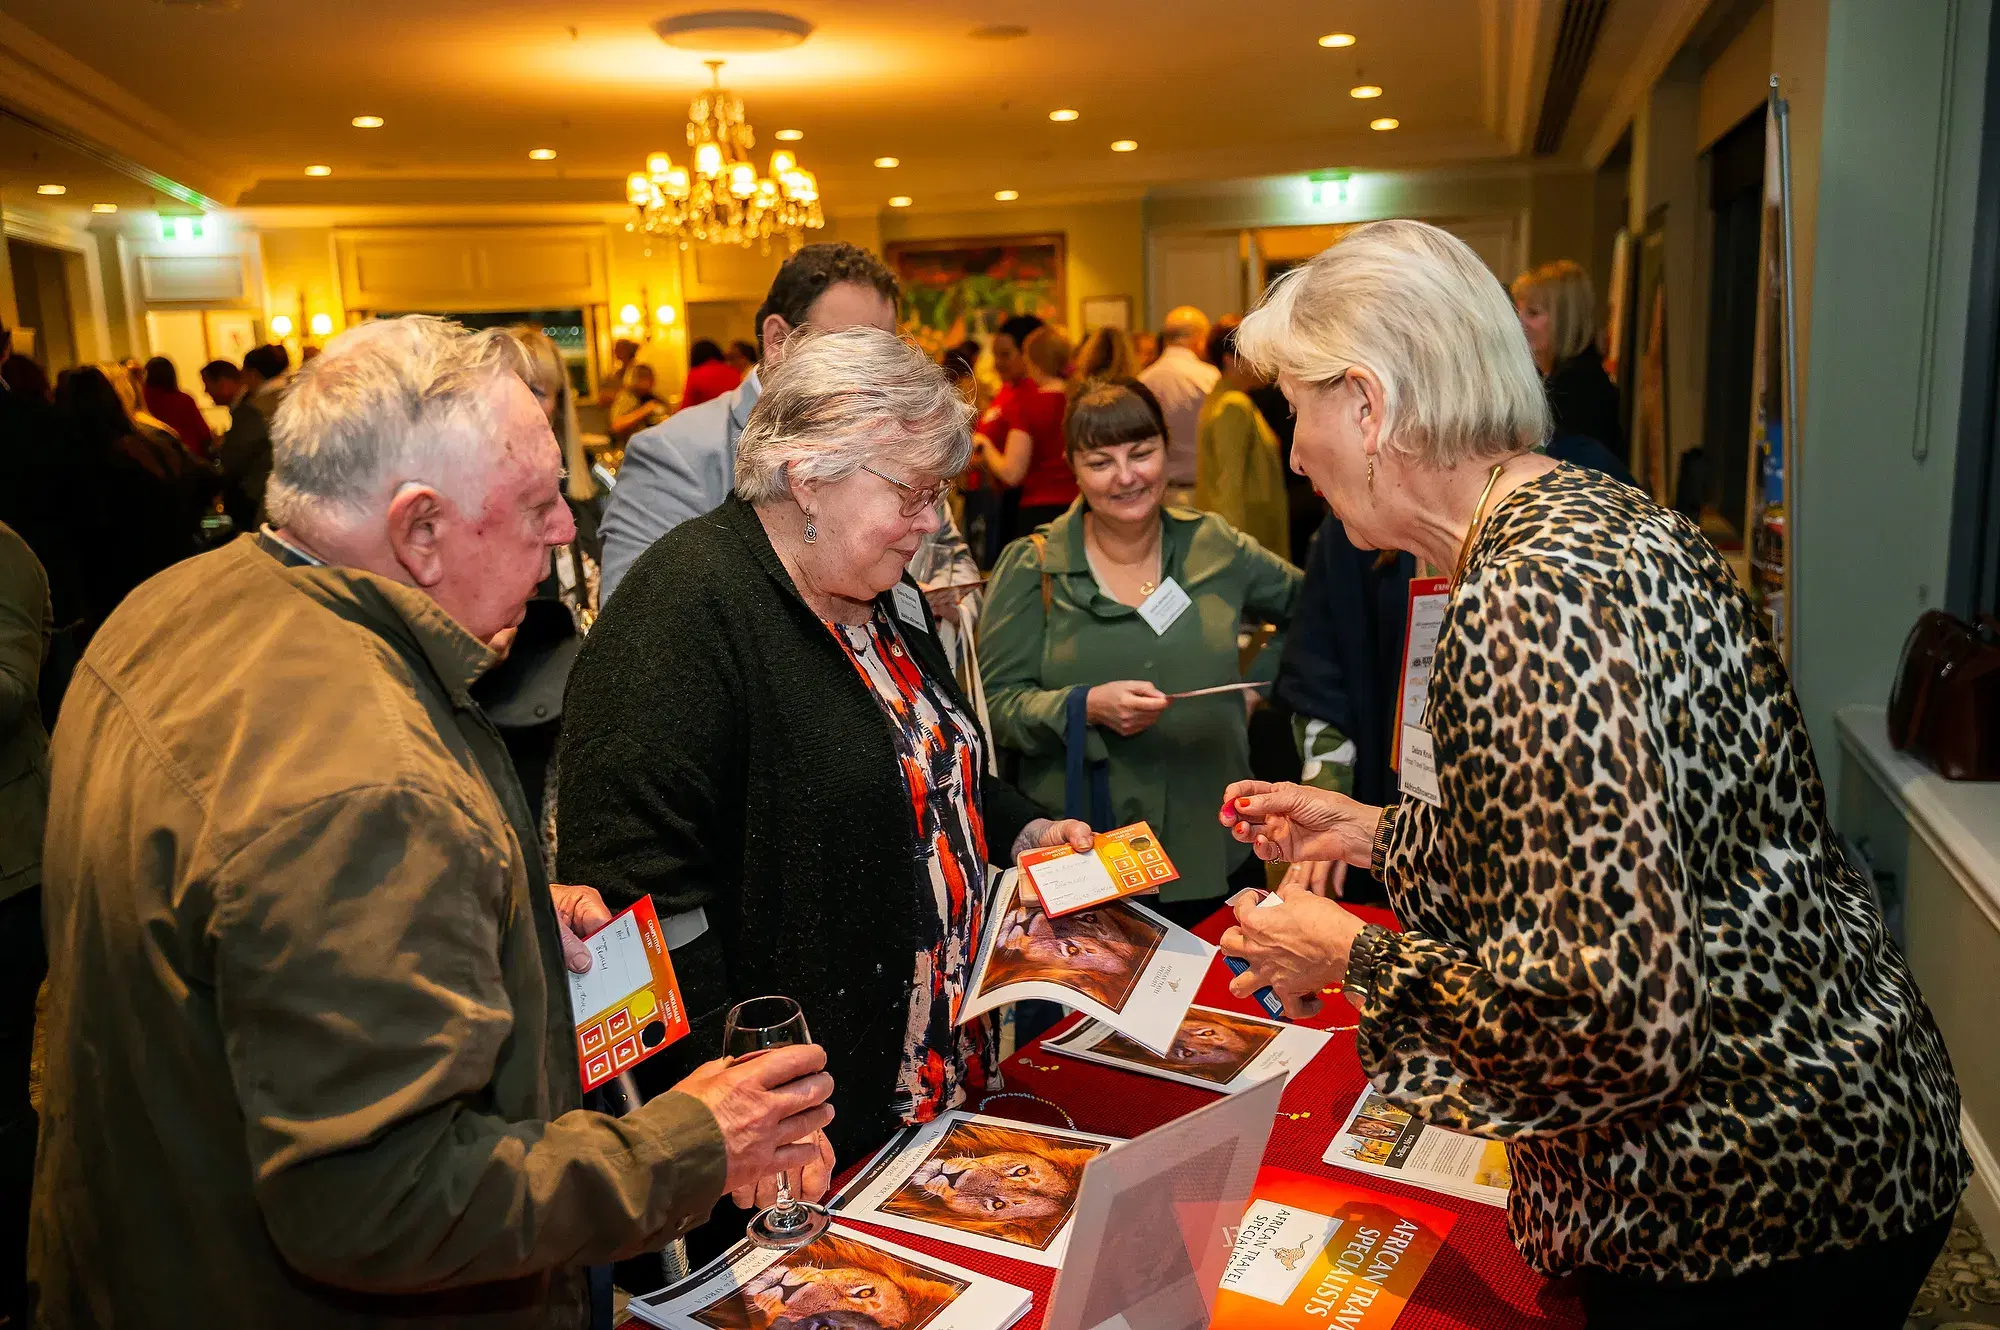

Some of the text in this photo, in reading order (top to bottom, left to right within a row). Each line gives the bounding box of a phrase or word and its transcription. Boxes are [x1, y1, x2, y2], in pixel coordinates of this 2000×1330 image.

[1145, 852, 1153, 860] 4
[1120, 860, 1128, 868] 3
[1154, 867, 1163, 875] 6
[1129, 875, 1138, 883] 5
[613, 1018, 625, 1029] 3
[586, 1034, 599, 1044] 5
[619, 1048, 632, 1058] 4
[593, 1062, 605, 1073] 6
[1253, 1208, 1291, 1249] AFRICAN
[1361, 1218, 1419, 1286] AFRICAN
[1224, 1250, 1261, 1285] TRAVEL
[1304, 1226, 1381, 1318] SPECIALISTS
